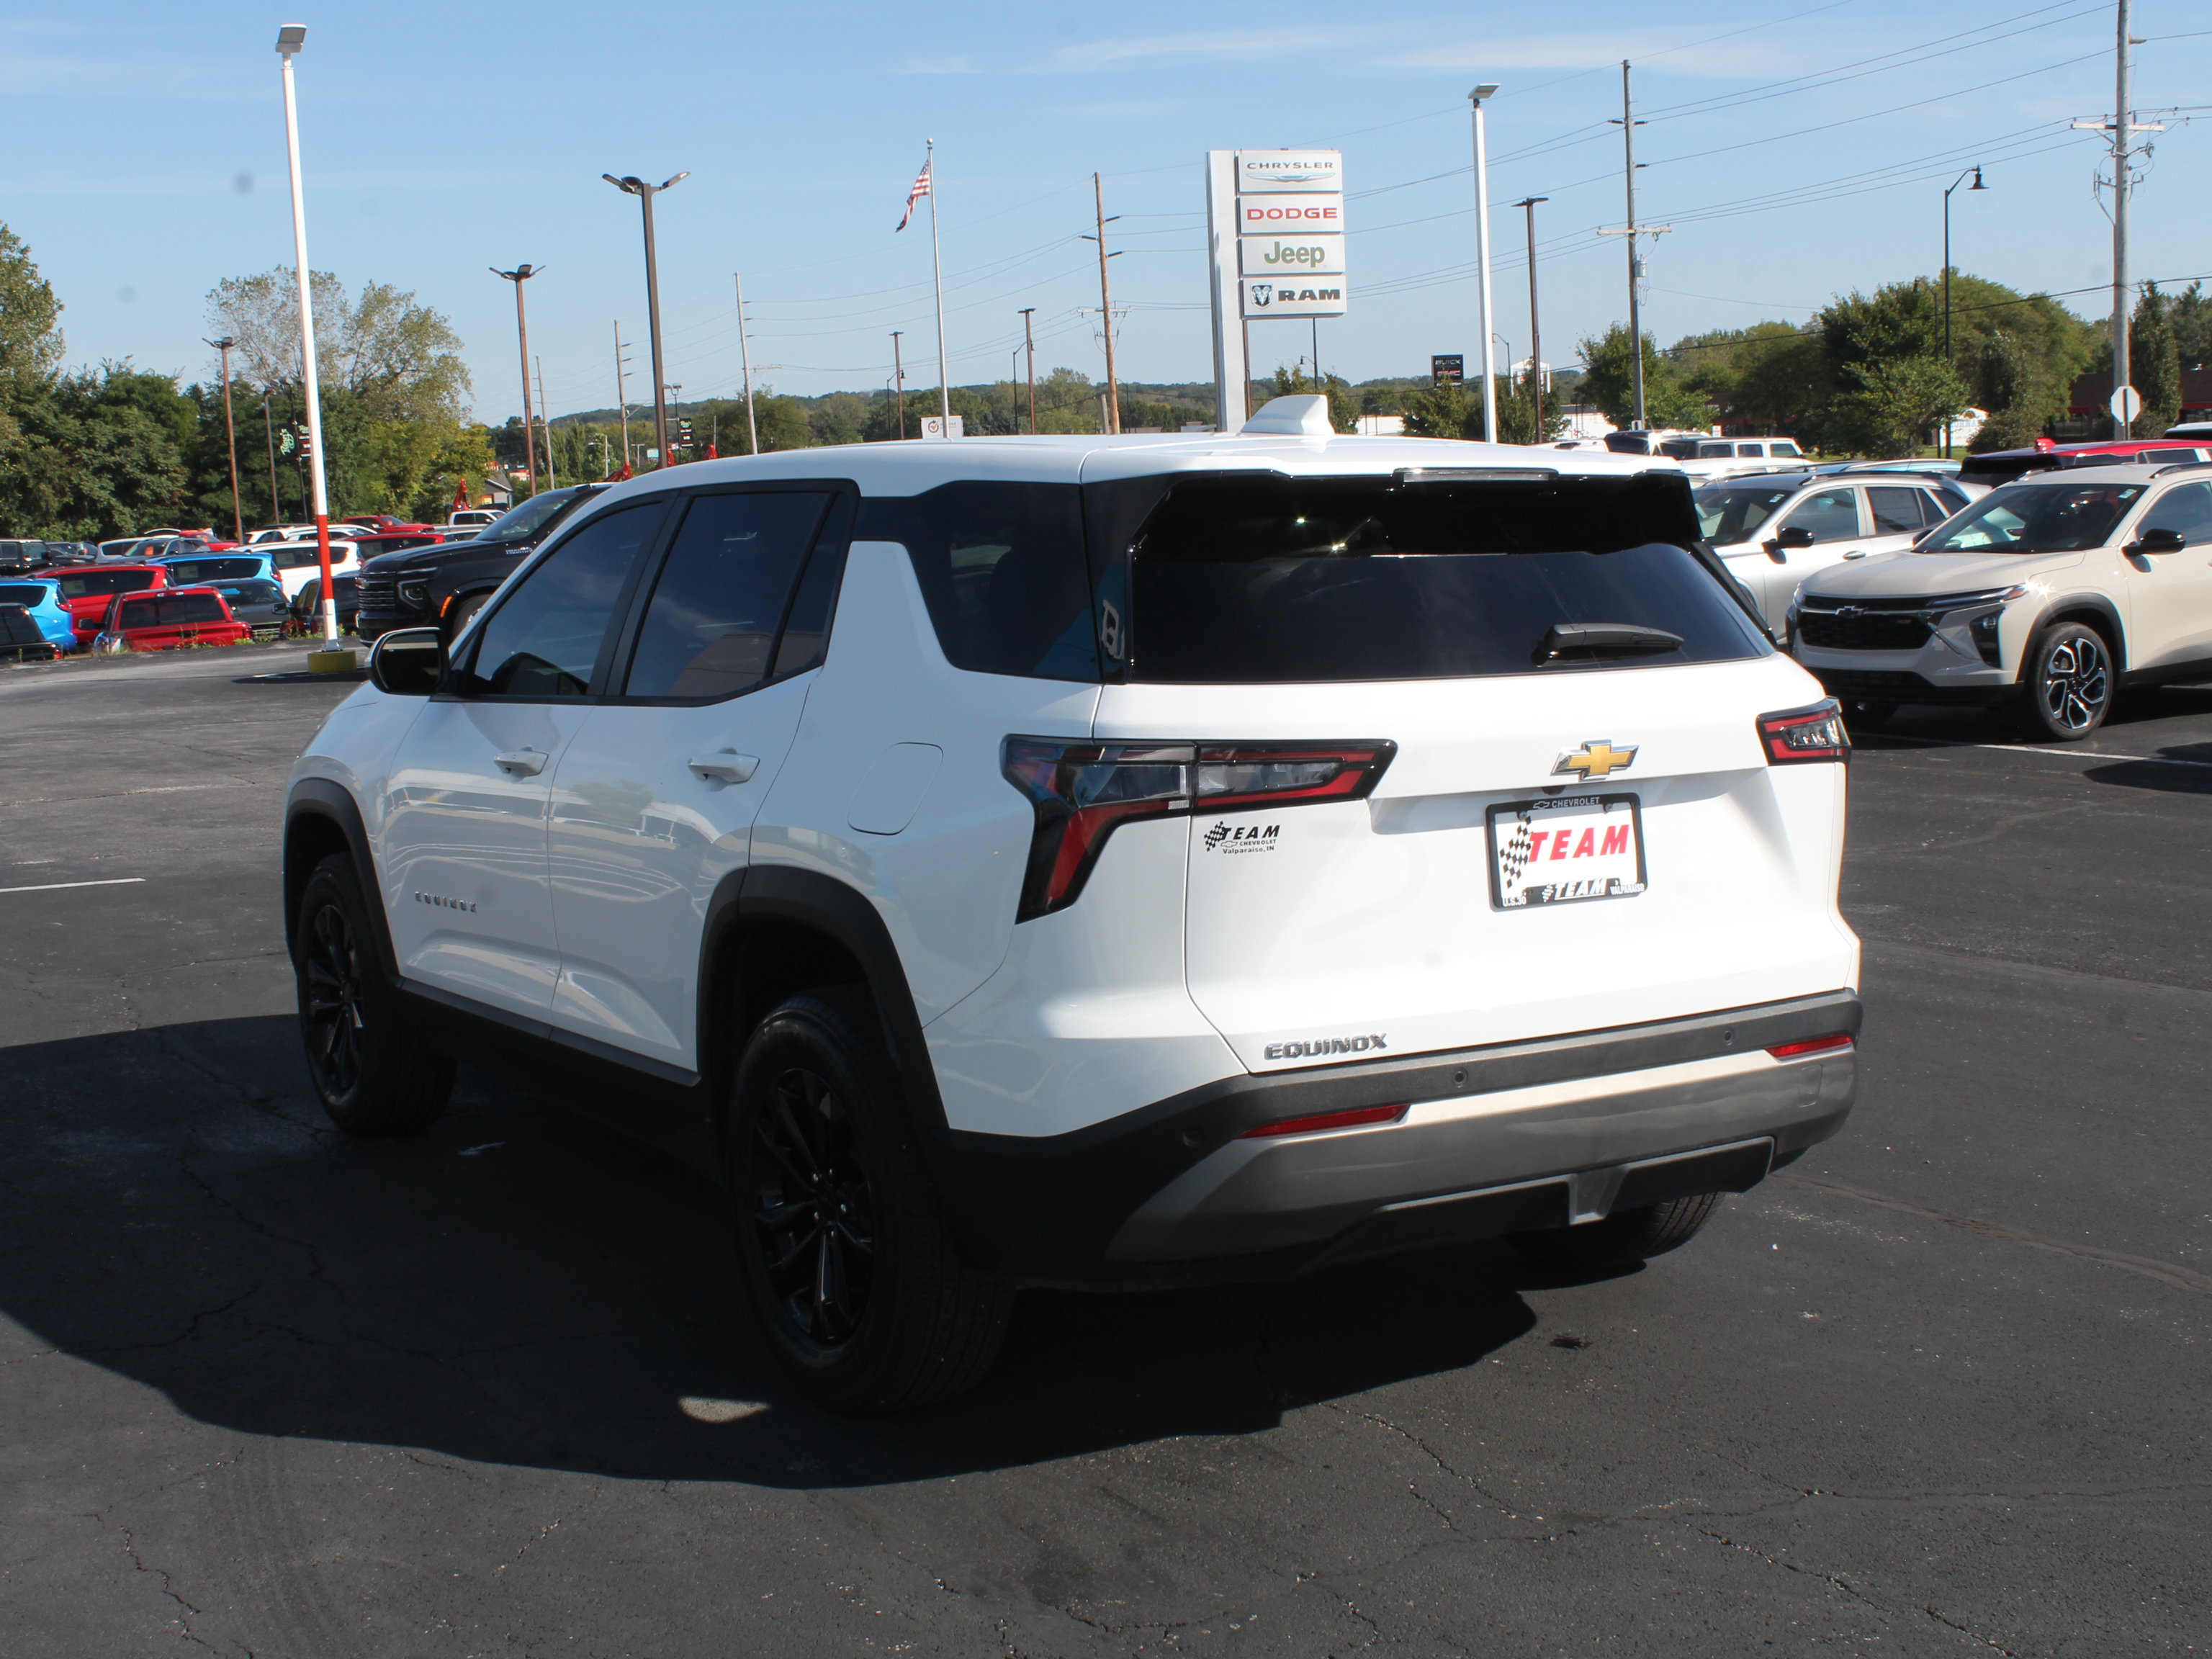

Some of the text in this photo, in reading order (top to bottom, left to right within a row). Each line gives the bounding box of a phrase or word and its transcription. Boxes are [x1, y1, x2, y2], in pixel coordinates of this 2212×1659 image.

[1247, 161, 1334, 170] CHRYSLER
[1247, 207, 1338, 220] DODGE
[1264, 240, 1326, 268] Jeep
[1277, 289, 1341, 301] RAM
[1551, 796, 1601, 809] CHEVROLET
[1220, 824, 1280, 840] TEAM
[1527, 824, 1630, 863] TEAM
[1554, 878, 1607, 900] TEAM
[1609, 883, 1645, 896] VALPARAISO
[1263, 1031, 1388, 1061] EQUINOX
